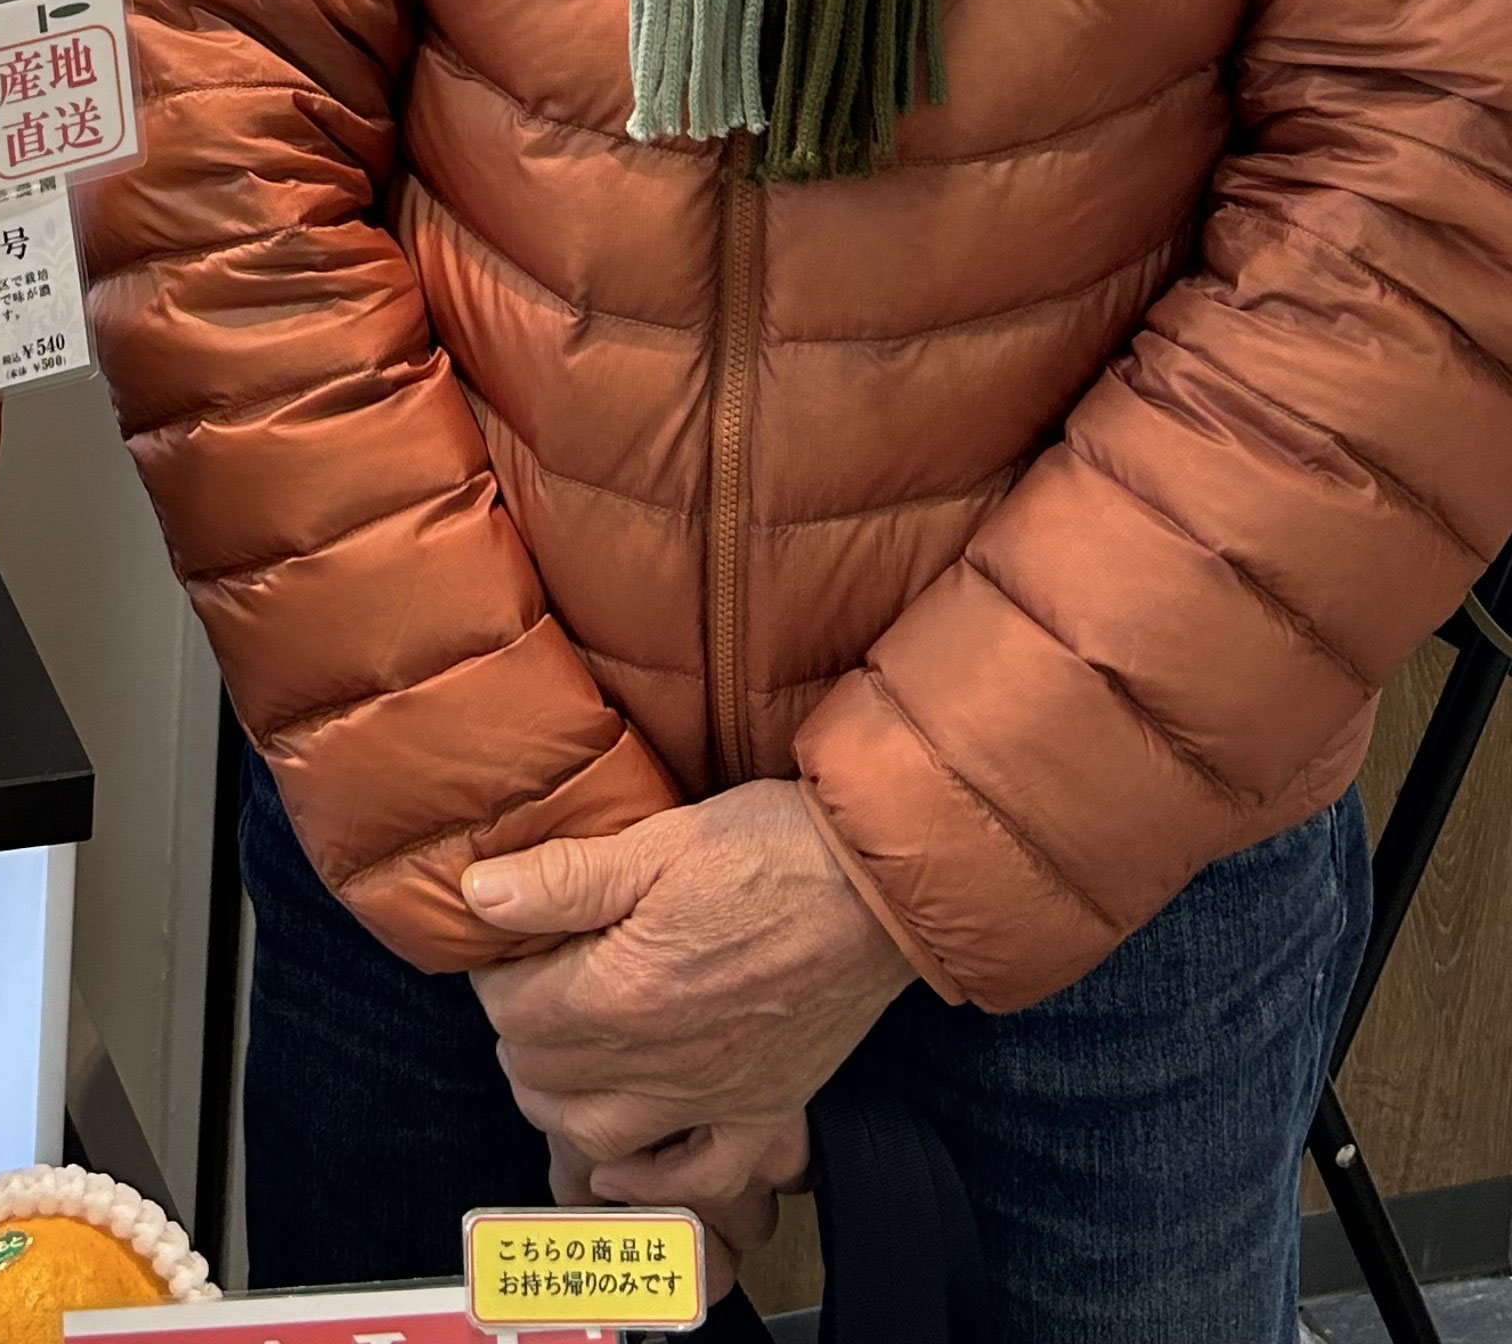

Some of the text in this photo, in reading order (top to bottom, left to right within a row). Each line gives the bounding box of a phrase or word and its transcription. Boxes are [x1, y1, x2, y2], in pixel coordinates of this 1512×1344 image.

[2, 96, 105, 167] 直送
[499, 1237, 667, 1262] こちらの商品は
[499, 1270, 683, 1297] お持ち帰りのみです
